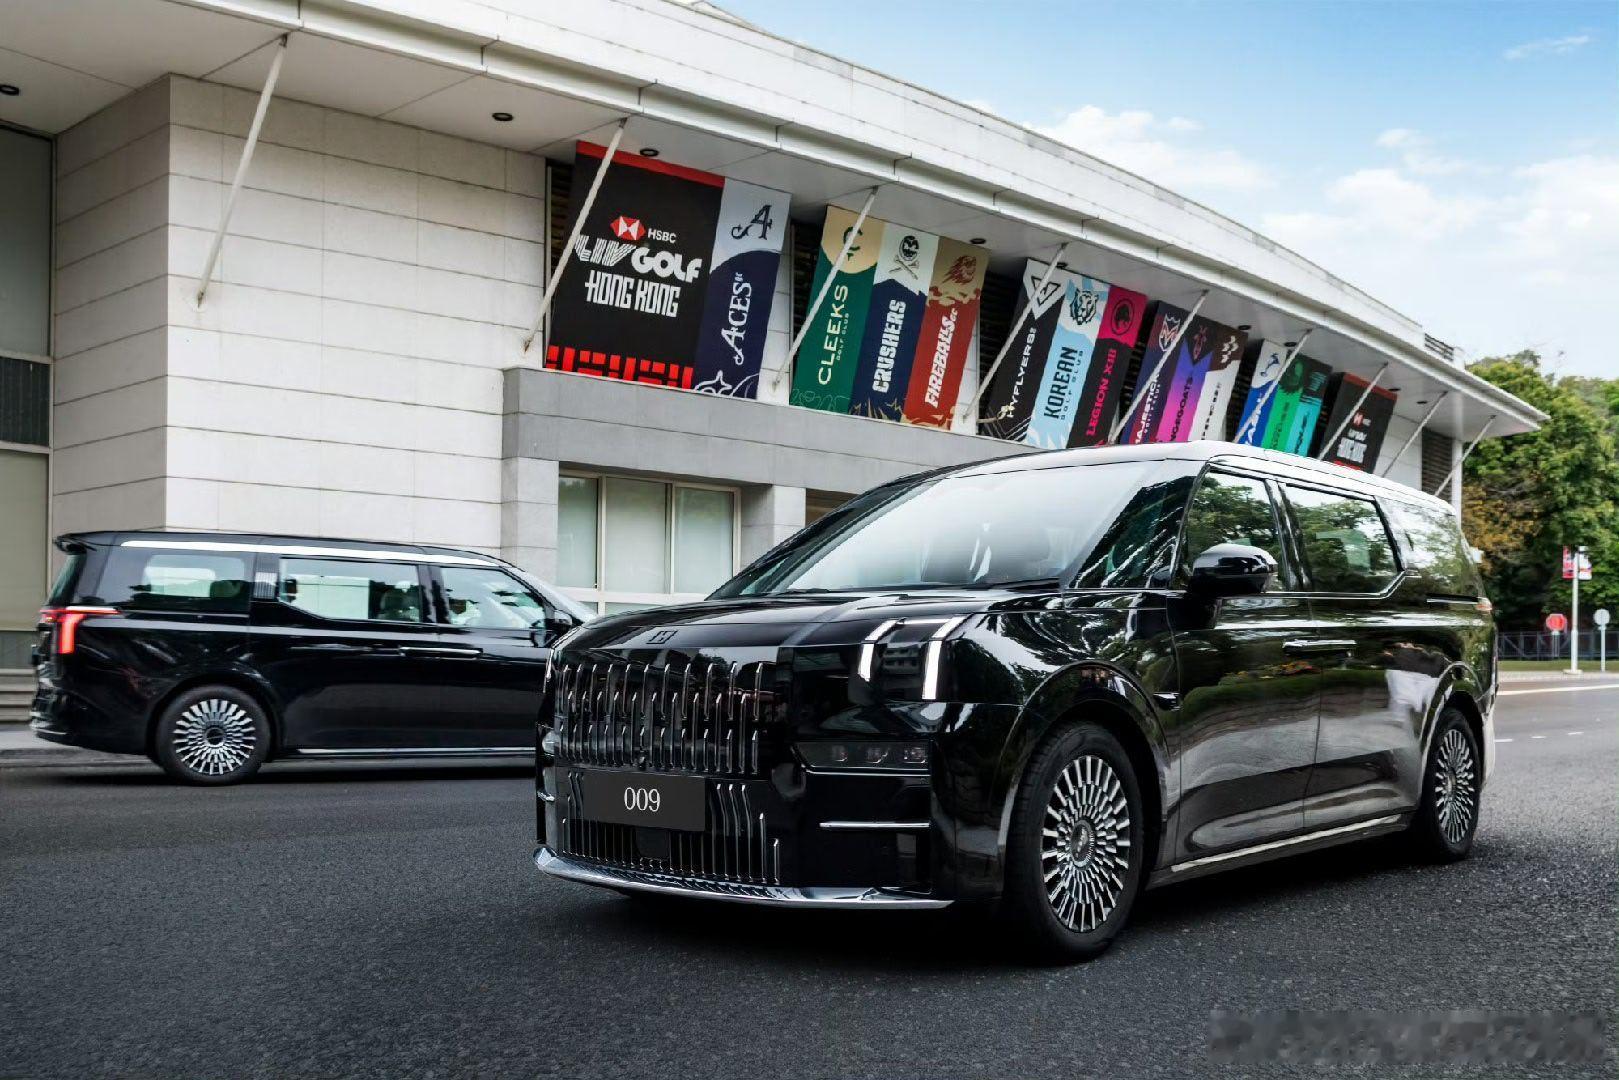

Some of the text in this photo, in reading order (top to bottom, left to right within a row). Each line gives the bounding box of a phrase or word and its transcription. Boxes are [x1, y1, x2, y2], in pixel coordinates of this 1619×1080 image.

[574, 234, 703, 283] LIV GOLF
[647, 228, 677, 244] HSBC
[584, 270, 682, 319] HONG KONG
[721, 281, 752, 366] ACES
[818, 284, 849, 386] CLEEKS
[872, 299, 906, 394] CRUSHERS
[924, 315, 955, 409] FIREBALLS
[1044, 346, 1078, 420] KOREAN
[1086, 377, 1111, 437] LEGION
[624, 787, 661, 812] 009
